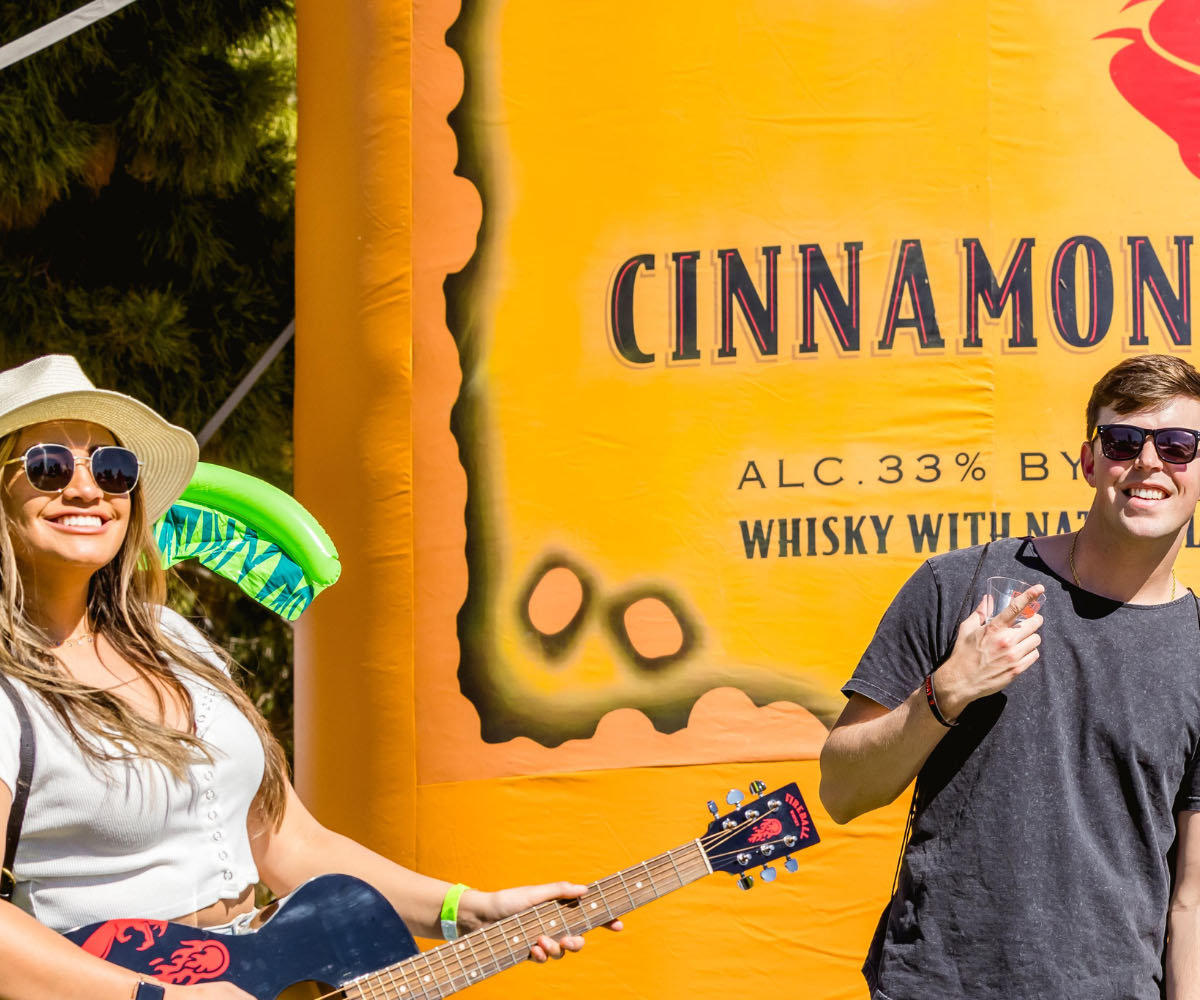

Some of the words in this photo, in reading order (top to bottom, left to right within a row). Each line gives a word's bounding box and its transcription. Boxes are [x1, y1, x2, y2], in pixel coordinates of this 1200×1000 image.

[608, 235, 1194, 366] CINNAMON
[1020, 452, 1082, 482] BY
[739, 514, 894, 560] WHISKY
[907, 510, 1010, 553] WITH
[784, 792, 811, 840] FIREBALL
